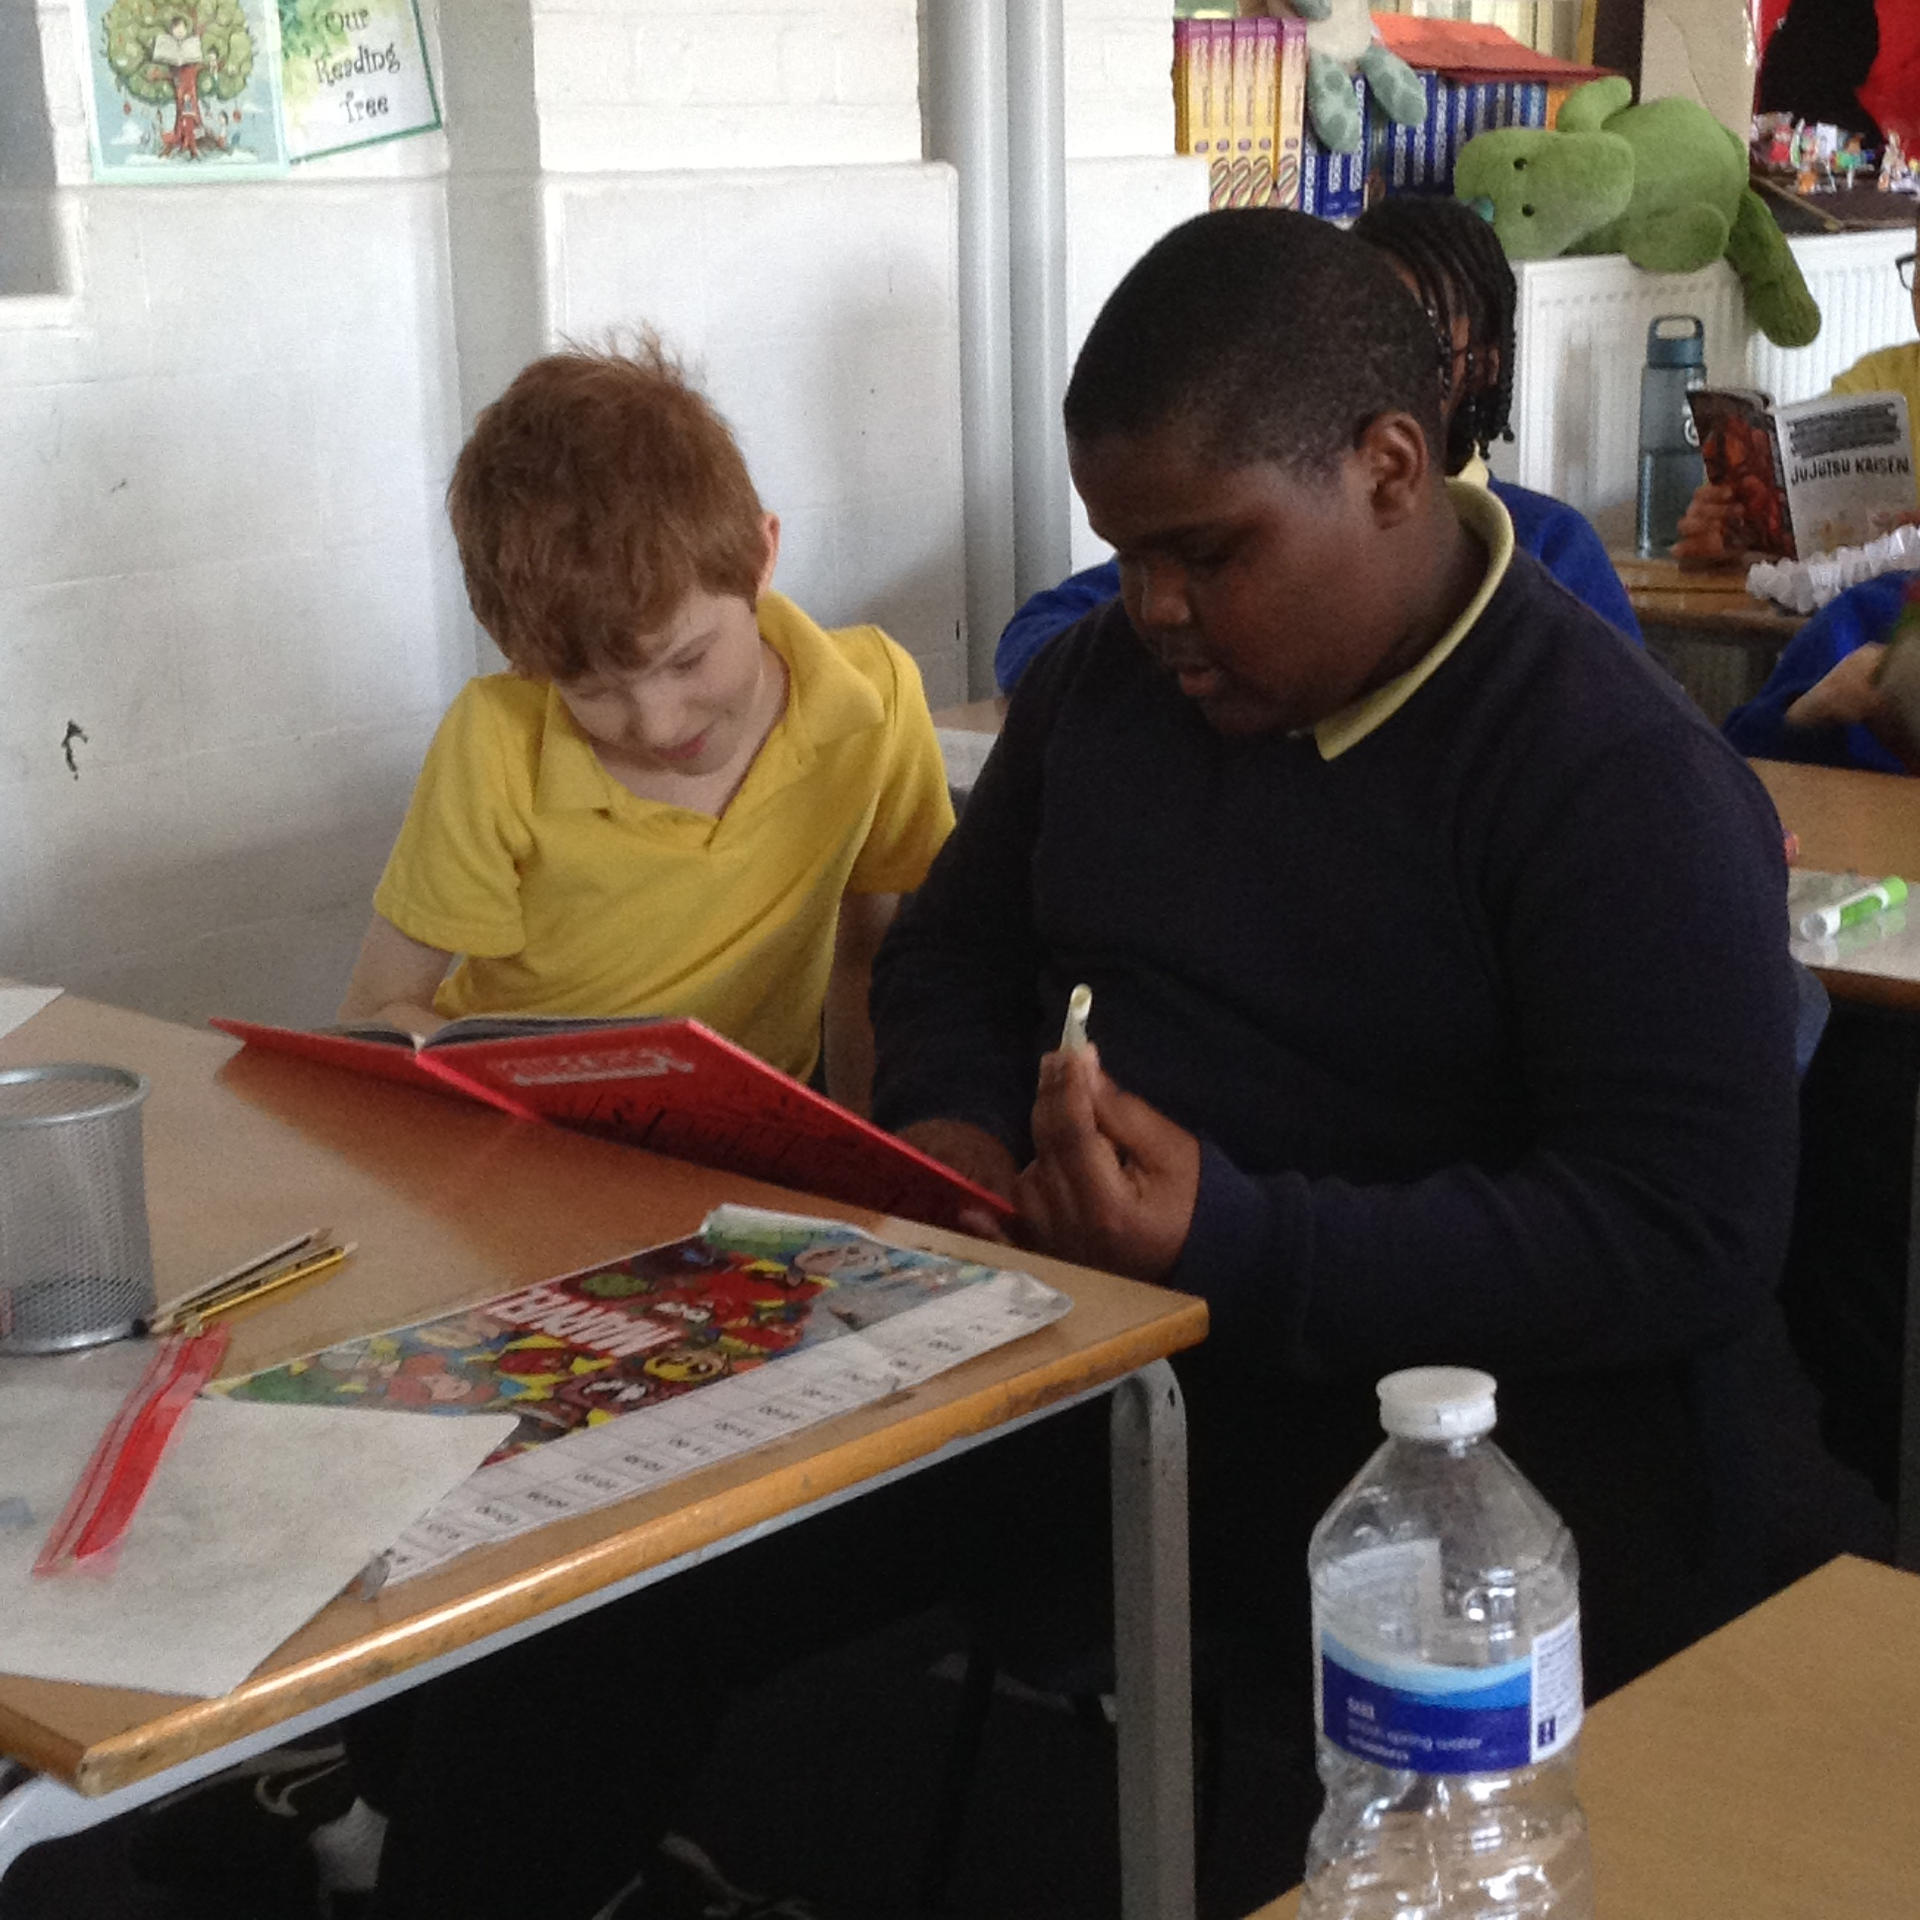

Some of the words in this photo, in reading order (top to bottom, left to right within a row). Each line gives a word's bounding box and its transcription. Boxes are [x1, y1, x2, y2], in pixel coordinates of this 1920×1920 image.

[325, 8, 369, 36] Our
[315, 42, 401, 86] Reading
[339, 90, 389, 123] Tree
[1790, 457, 1850, 485] JUJUTSU
[1854, 454, 1911, 474] KAISEN
[483, 1285, 683, 1358] MARVEL
[1436, 1737, 1483, 1751] water
